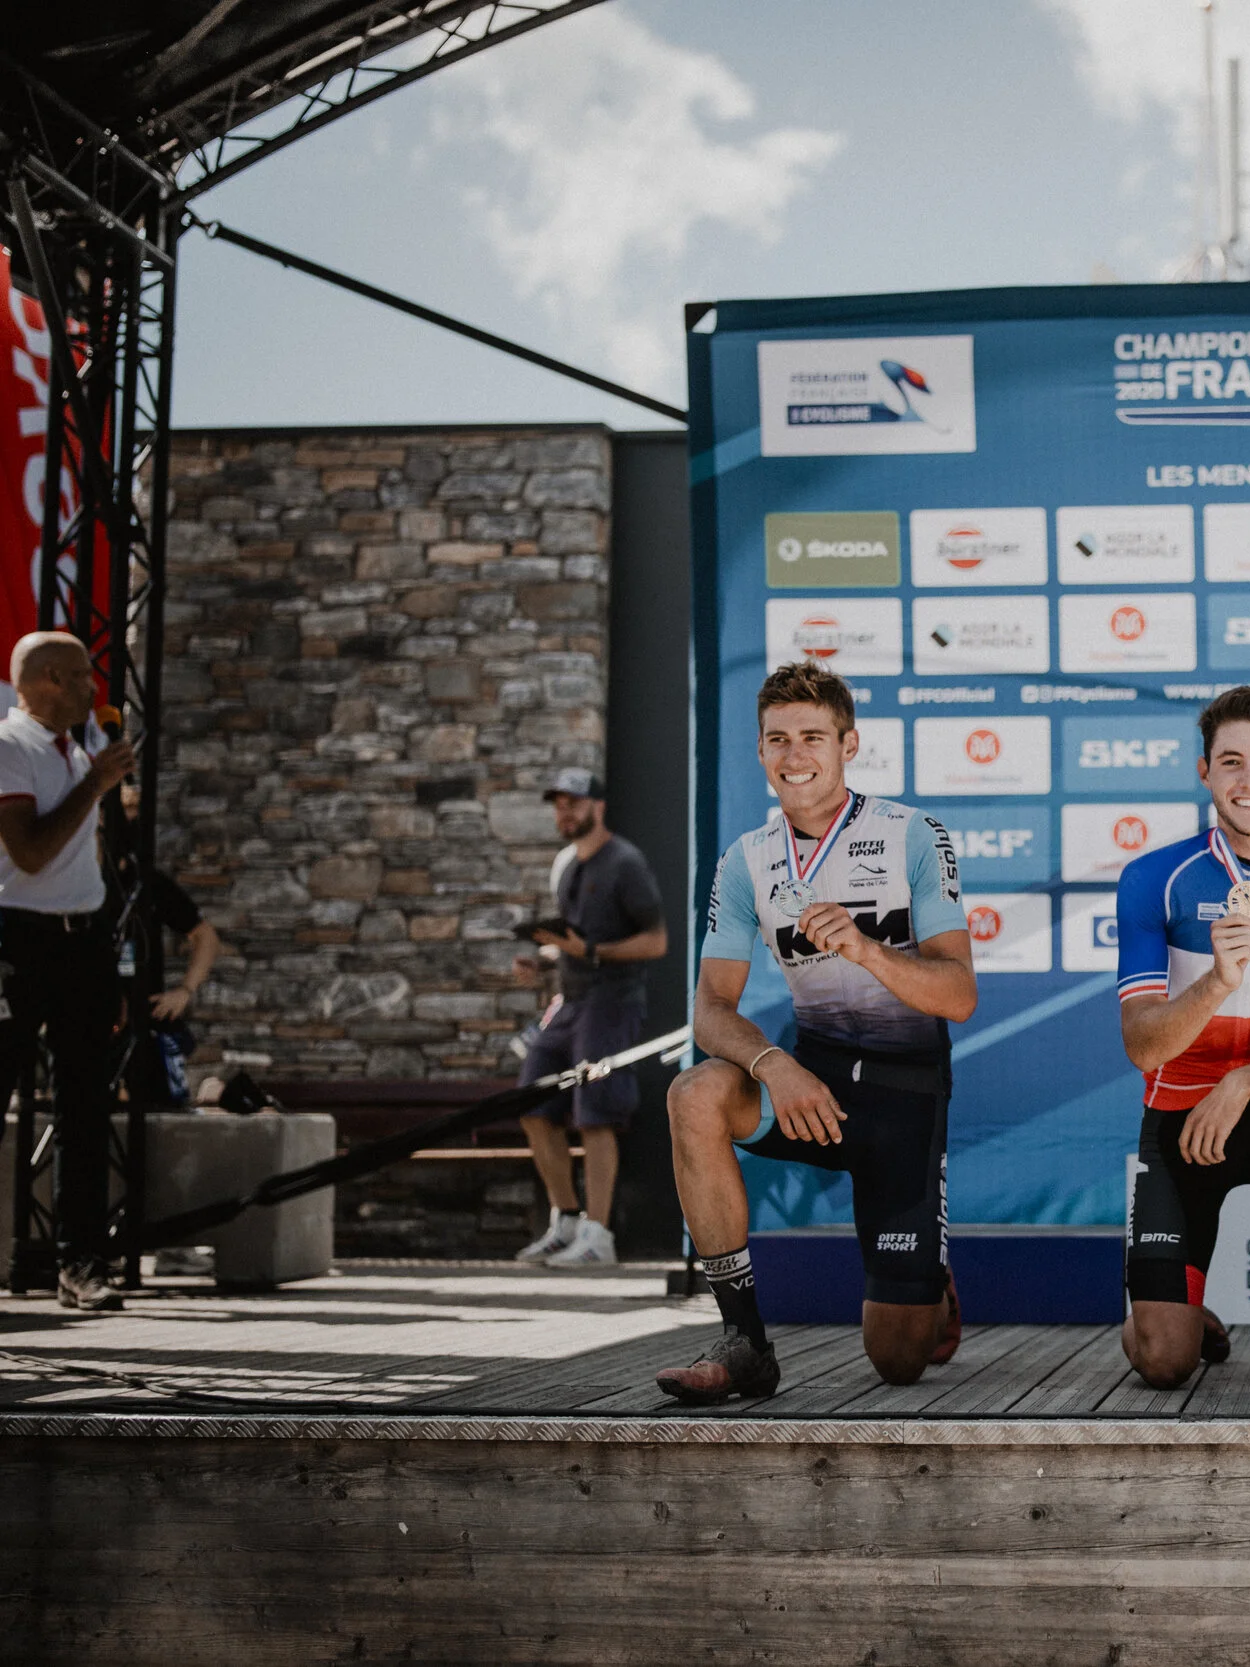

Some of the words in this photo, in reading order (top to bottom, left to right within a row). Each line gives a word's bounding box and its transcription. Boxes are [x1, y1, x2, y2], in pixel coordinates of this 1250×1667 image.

[1146, 465, 1195, 487] LES
[1078, 739, 1181, 768] SKF
[847, 847, 886, 858] SPORT
[878, 1233, 917, 1242] DIFFU
[1140, 1232, 1182, 1244] BMC
[876, 1242, 919, 1251] SPORT
